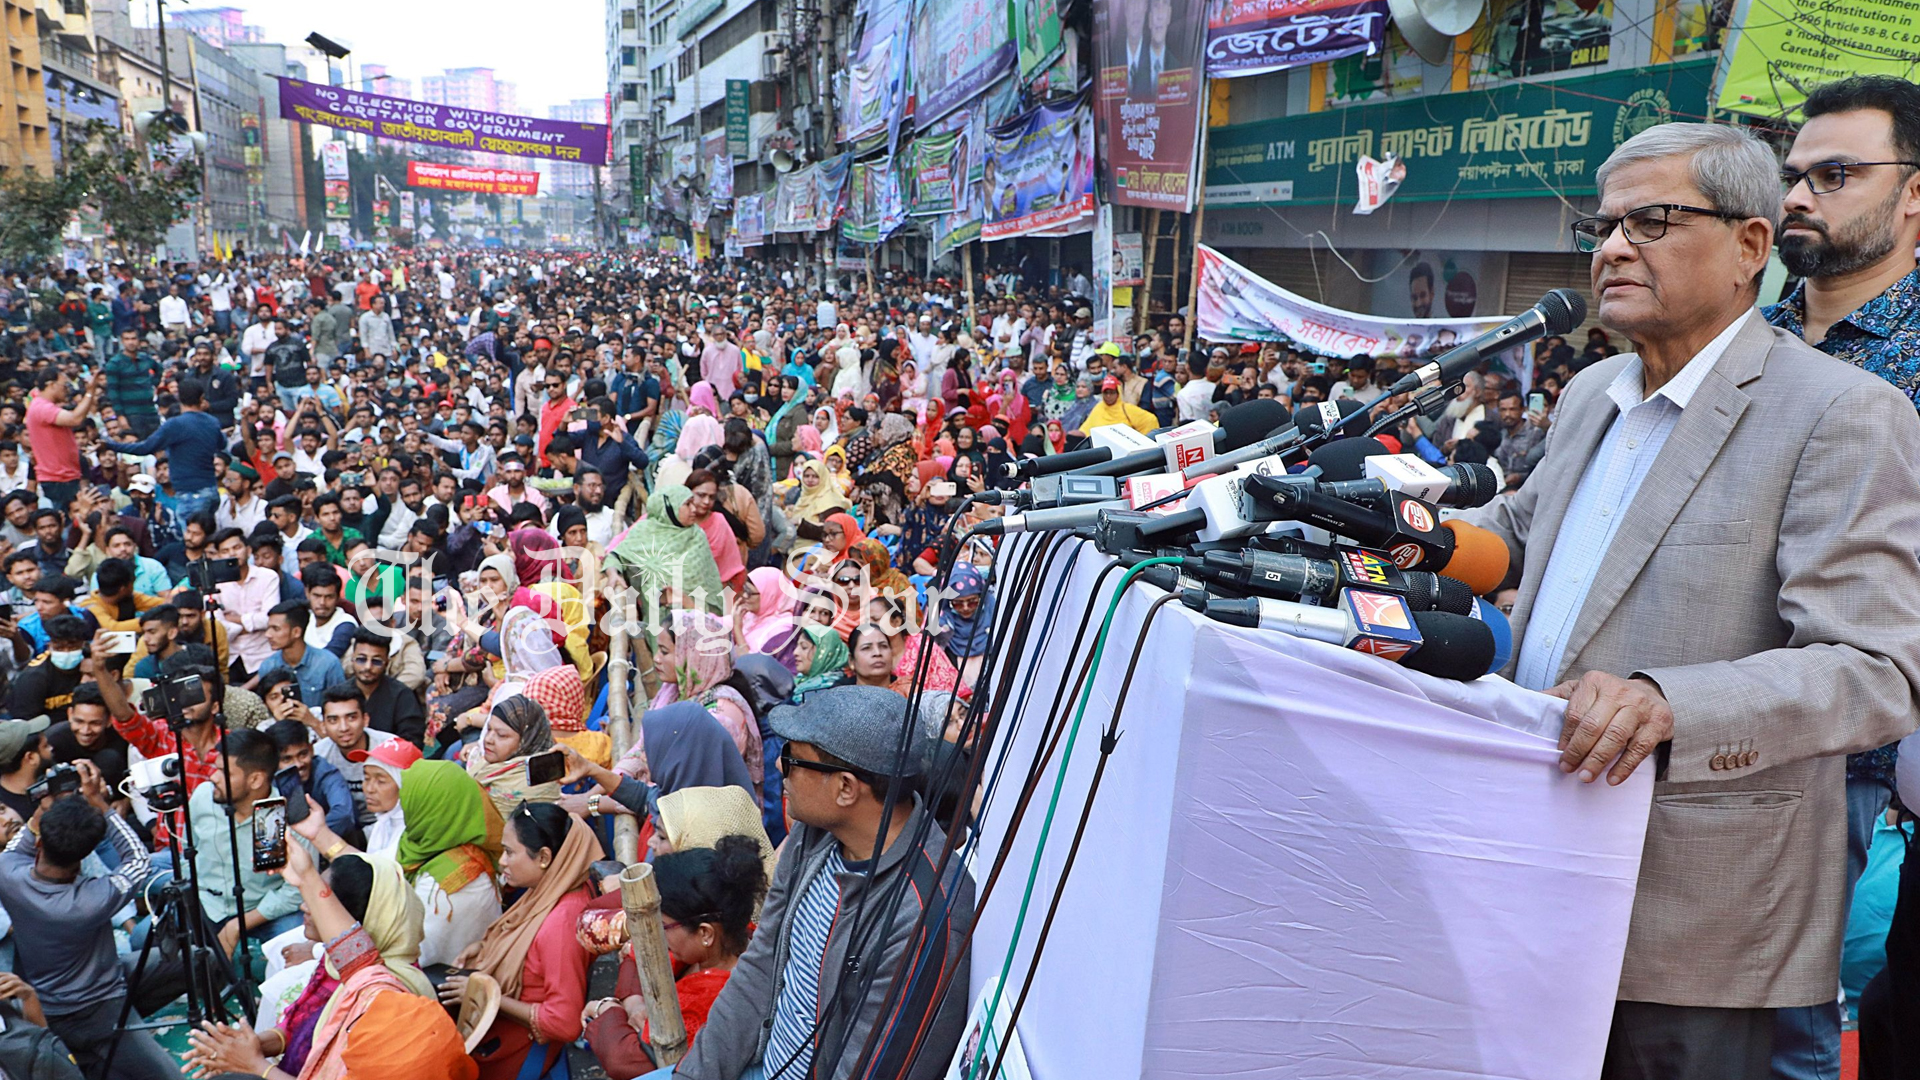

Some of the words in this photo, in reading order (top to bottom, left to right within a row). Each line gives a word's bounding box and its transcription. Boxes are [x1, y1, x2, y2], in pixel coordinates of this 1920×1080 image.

[1793, 12, 1821, 26] 1996
[1824, 19, 1859, 33] Article
[1892, 31, 1900, 40] C
[1901, 33, 1910, 42] &
[1820, 1, 1897, 23] Constitution
[1900, 14, 1912, 26] in
[1780, 41, 1840, 61] Caretaker
[315, 88, 339, 101] NO
[347, 95, 438, 115] ELECTION
[448, 109, 533, 128] WITHOUT
[329, 102, 436, 127] CARETAKER
[444, 119, 565, 143] GOVERNMENT
[293, 104, 374, 132] বাংলাদেশ
[555, 145, 581, 160] দল
[1460, 109, 1593, 153] লিমিটেড
[1266, 140, 1295, 160] ATM
[1554, 159, 1585, 175] ঢাকা
[1296, 317, 1380, 355] সমাবেশ
[1348, 553, 1369, 582] NEWS
[1359, 554, 1390, 585] ATN
